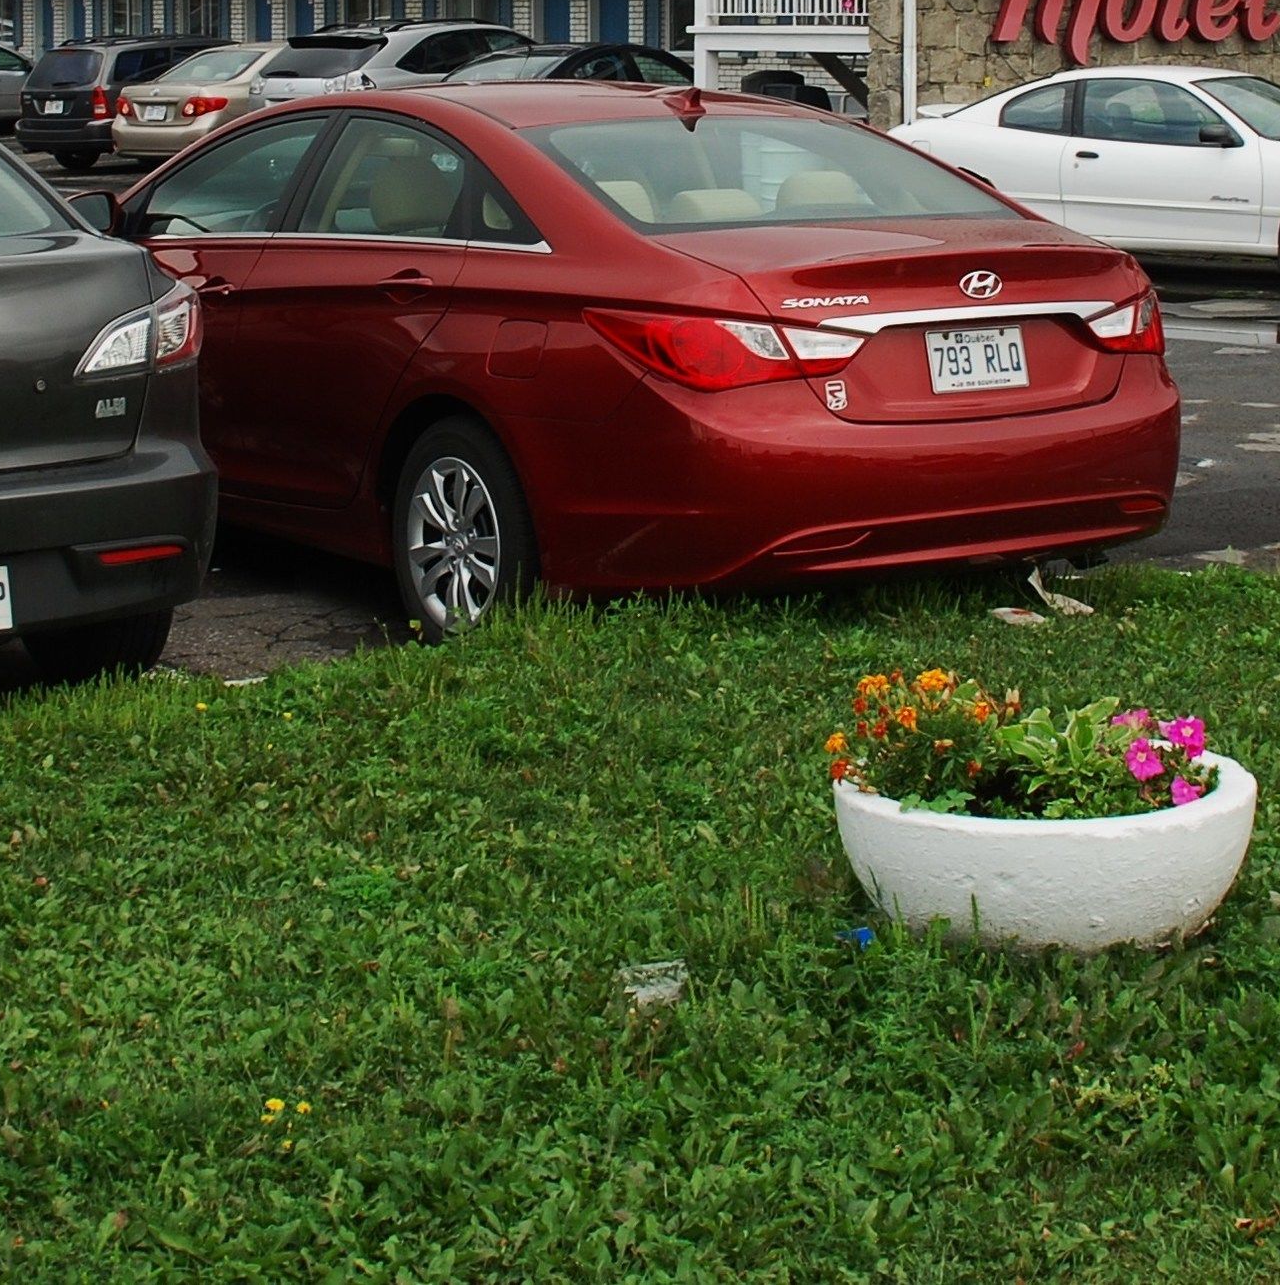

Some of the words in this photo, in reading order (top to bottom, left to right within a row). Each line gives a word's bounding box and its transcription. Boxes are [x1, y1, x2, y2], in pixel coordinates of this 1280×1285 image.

[781, 295, 870, 309] SONATA
[933, 345, 973, 377] 793
[984, 342, 1022, 373] RLQ
